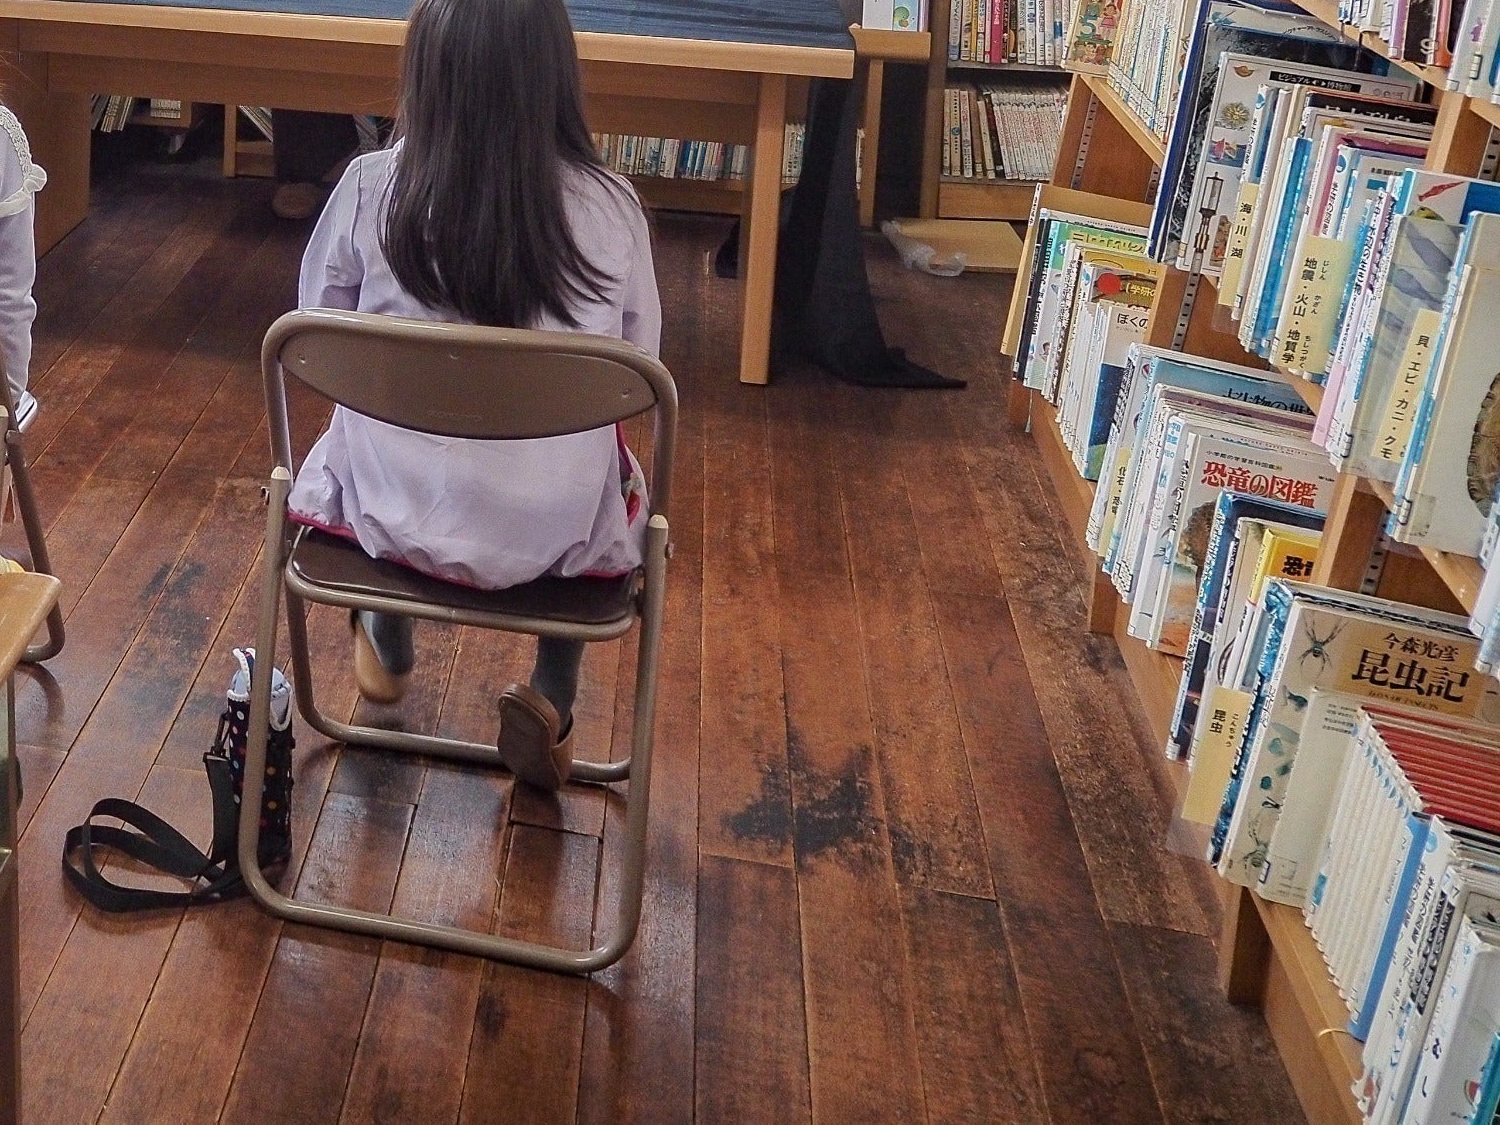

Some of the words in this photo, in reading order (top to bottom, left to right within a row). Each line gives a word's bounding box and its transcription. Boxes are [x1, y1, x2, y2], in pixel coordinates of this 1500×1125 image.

[1230, 202, 1253, 259] 海・川・湖
[1281, 257, 1318, 364] 地震・火山・地質学
[1380, 335, 1430, 460] 貝・エビ・カニ・クモ
[1200, 460, 1319, 508] 恐竜の図鑑
[1383, 631, 1460, 663] 今森光彦
[1351, 648, 1470, 704] 昆虫記
[1210, 708, 1226, 734] 昆虫
